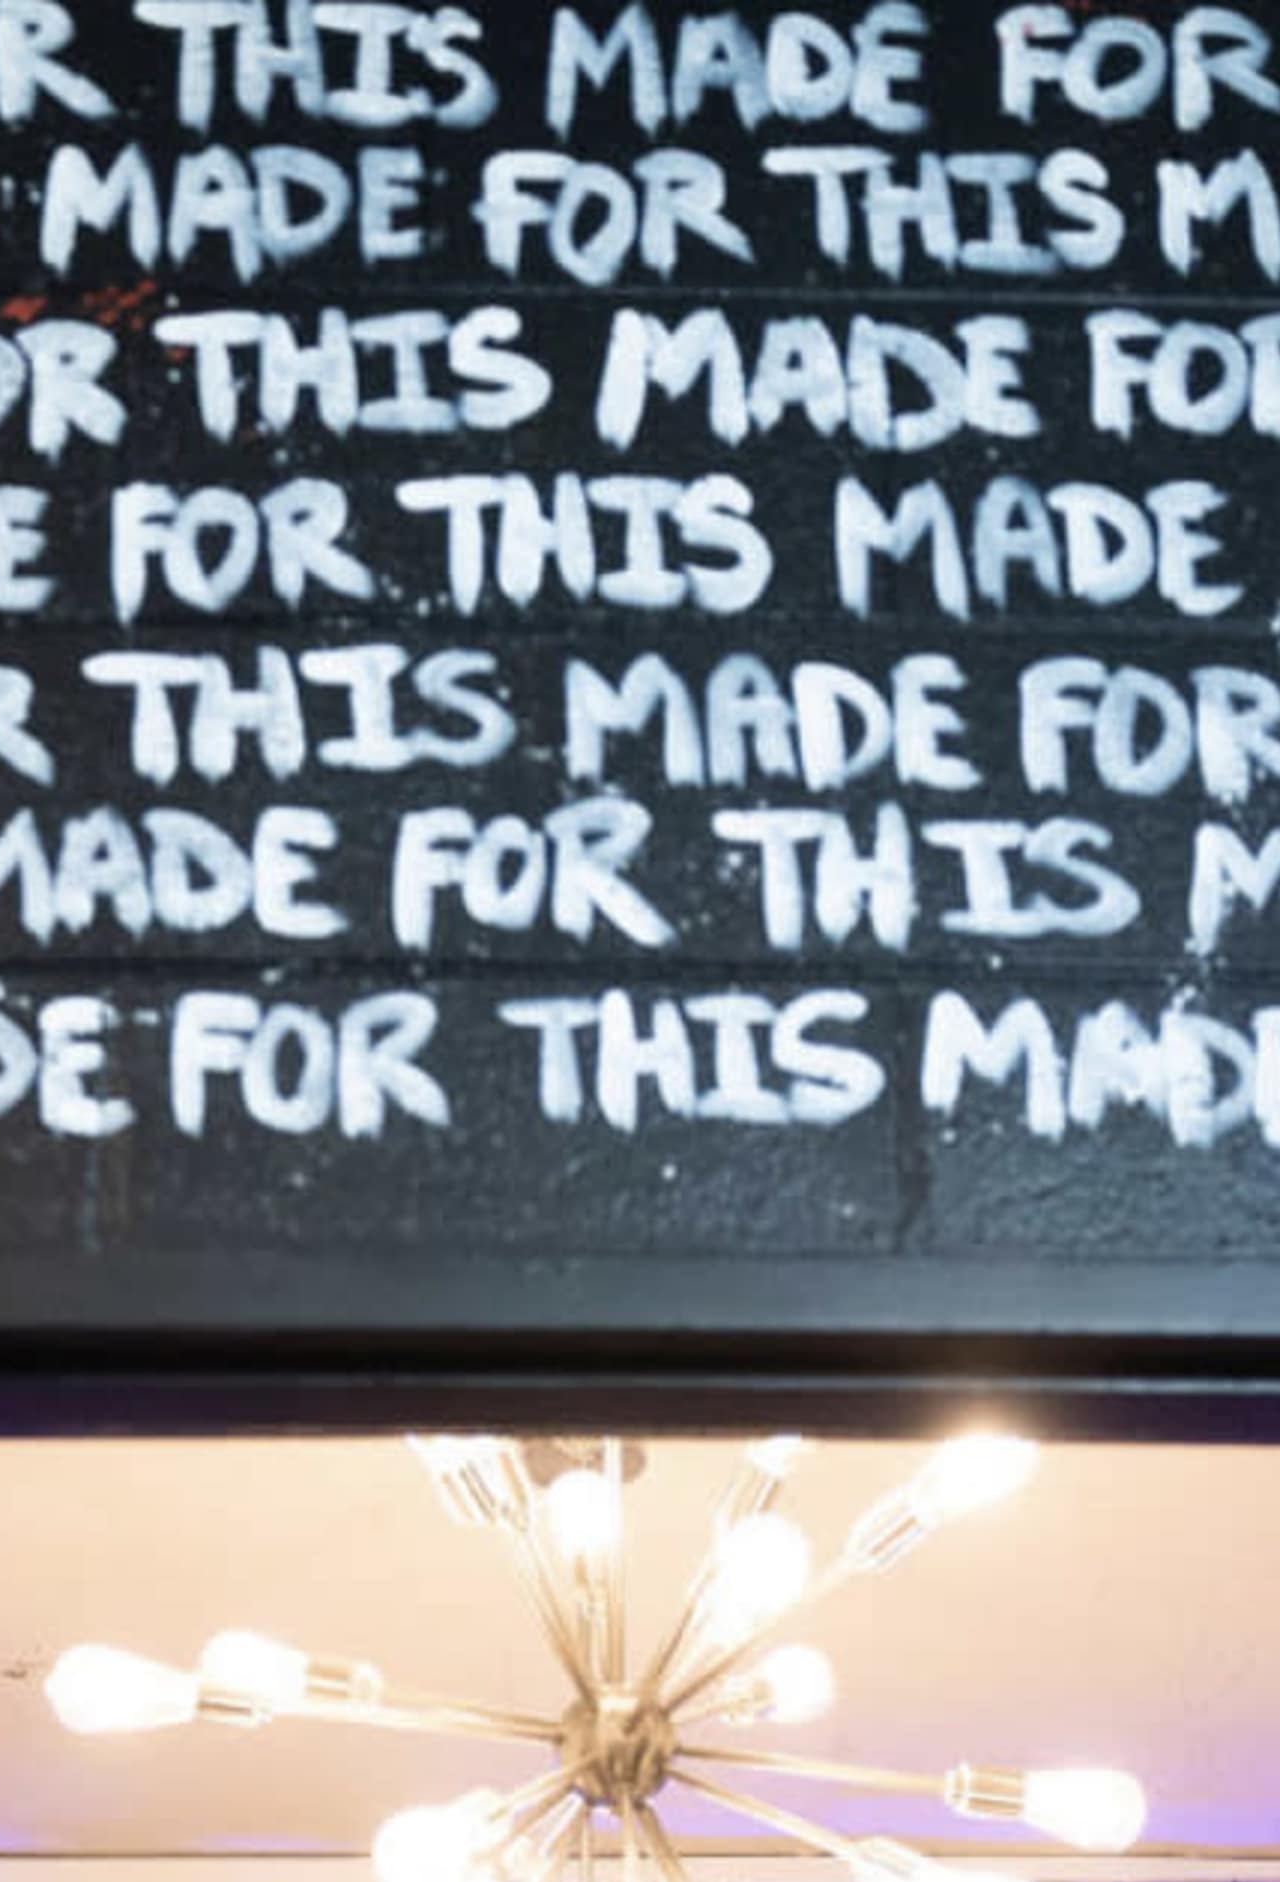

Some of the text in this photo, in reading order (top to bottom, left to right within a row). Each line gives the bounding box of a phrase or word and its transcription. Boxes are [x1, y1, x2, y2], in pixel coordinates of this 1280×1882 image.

[134, 0, 494, 128] THIS
[548, 2, 923, 133] MADE
[996, 5, 1280, 130] FOR
[41, 146, 422, 280] MADE
[474, 150, 750, 285] FOR
[763, 147, 1124, 276] THIS
[154, 306, 551, 439] THIS
[597, 309, 1038, 450] MADE
[112, 478, 372, 622] FOR
[396, 474, 772, 613] THIS
[836, 478, 1241, 619] MADE
[82, 644, 514, 783] THIS
[564, 655, 980, 791] MADE
[393, 798, 673, 947] FOR
[712, 804, 1139, 948] THIS
[171, 992, 448, 1137] FOR
[500, 990, 884, 1131] THIS
